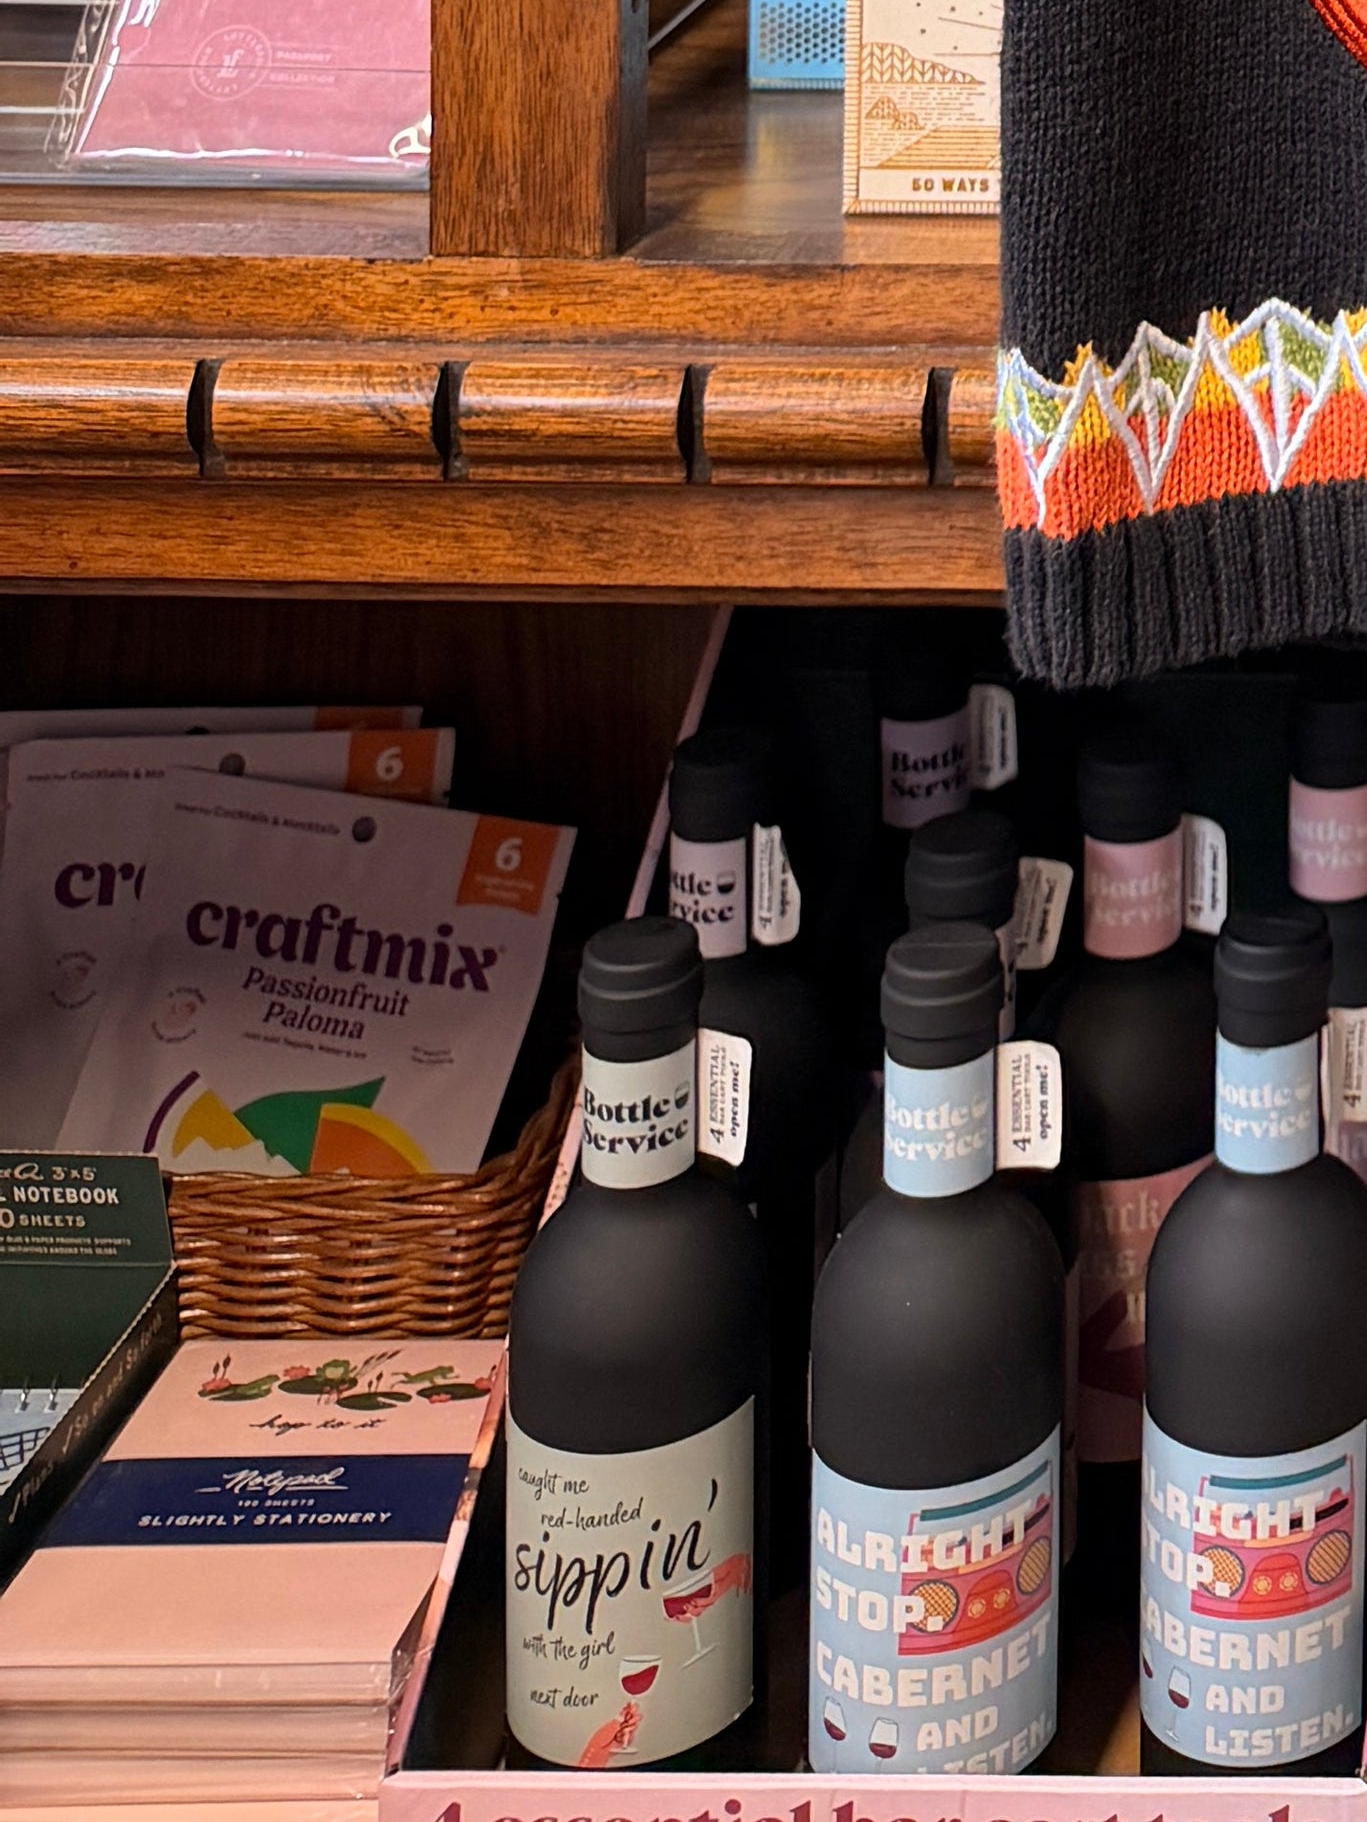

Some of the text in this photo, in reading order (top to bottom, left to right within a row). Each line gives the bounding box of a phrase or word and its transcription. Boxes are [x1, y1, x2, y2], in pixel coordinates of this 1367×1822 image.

[912, 178, 989, 192] 50 WAYS
[494, 837, 523, 872] 6
[186, 901, 499, 993] craftmix
[242, 965, 410, 1017] Passionfruit
[262, 1001, 365, 1040] Paloma
[583, 1087, 671, 1124] Bottle
[730, 1061, 740, 1138] open me!
[1036, 1064, 1052, 1140] open me!
[583, 1117, 688, 1154] Service
[709, 1127, 724, 1144] 4
[1012, 1136, 1031, 1152] 4
[14, 1186, 119, 1204] NOTEBOOK
[19, 1214, 86, 1228] SHEETS
[223, 1466, 346, 1496] Notepad
[518, 1466, 590, 1500] caught me
[138, 1512, 392, 1527] SLIGHTLY STATIONERY
[541, 1496, 643, 1531] red-handed
[816, 1500, 1034, 1574] ALRIGHT
[514, 1478, 718, 1635] sippin'
[816, 1565, 944, 1633] STOP.
[523, 1631, 615, 1670] with the girl
[816, 1613, 1051, 1707] CABERNET
[530, 1686, 599, 1708] next door
[1205, 1685, 1285, 1715] AND
[916, 1706, 999, 1752] AND
[1205, 1704, 1354, 1757] LISTEN.
